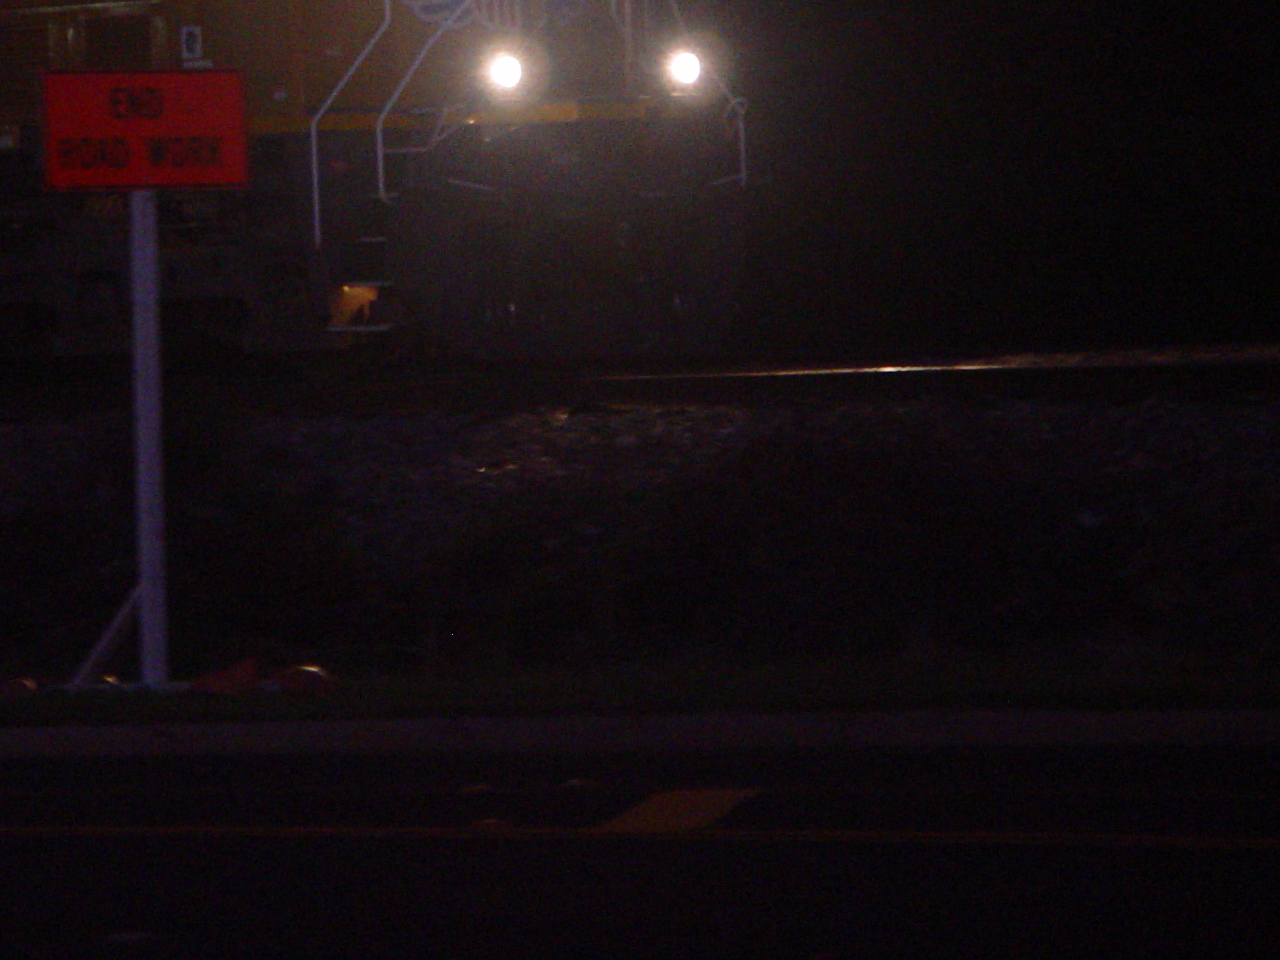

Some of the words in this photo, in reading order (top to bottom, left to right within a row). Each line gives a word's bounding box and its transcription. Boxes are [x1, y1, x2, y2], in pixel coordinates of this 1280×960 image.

[110, 87, 164, 119] END
[57, 136, 131, 170] ROAD
[147, 135, 225, 168] WORK
